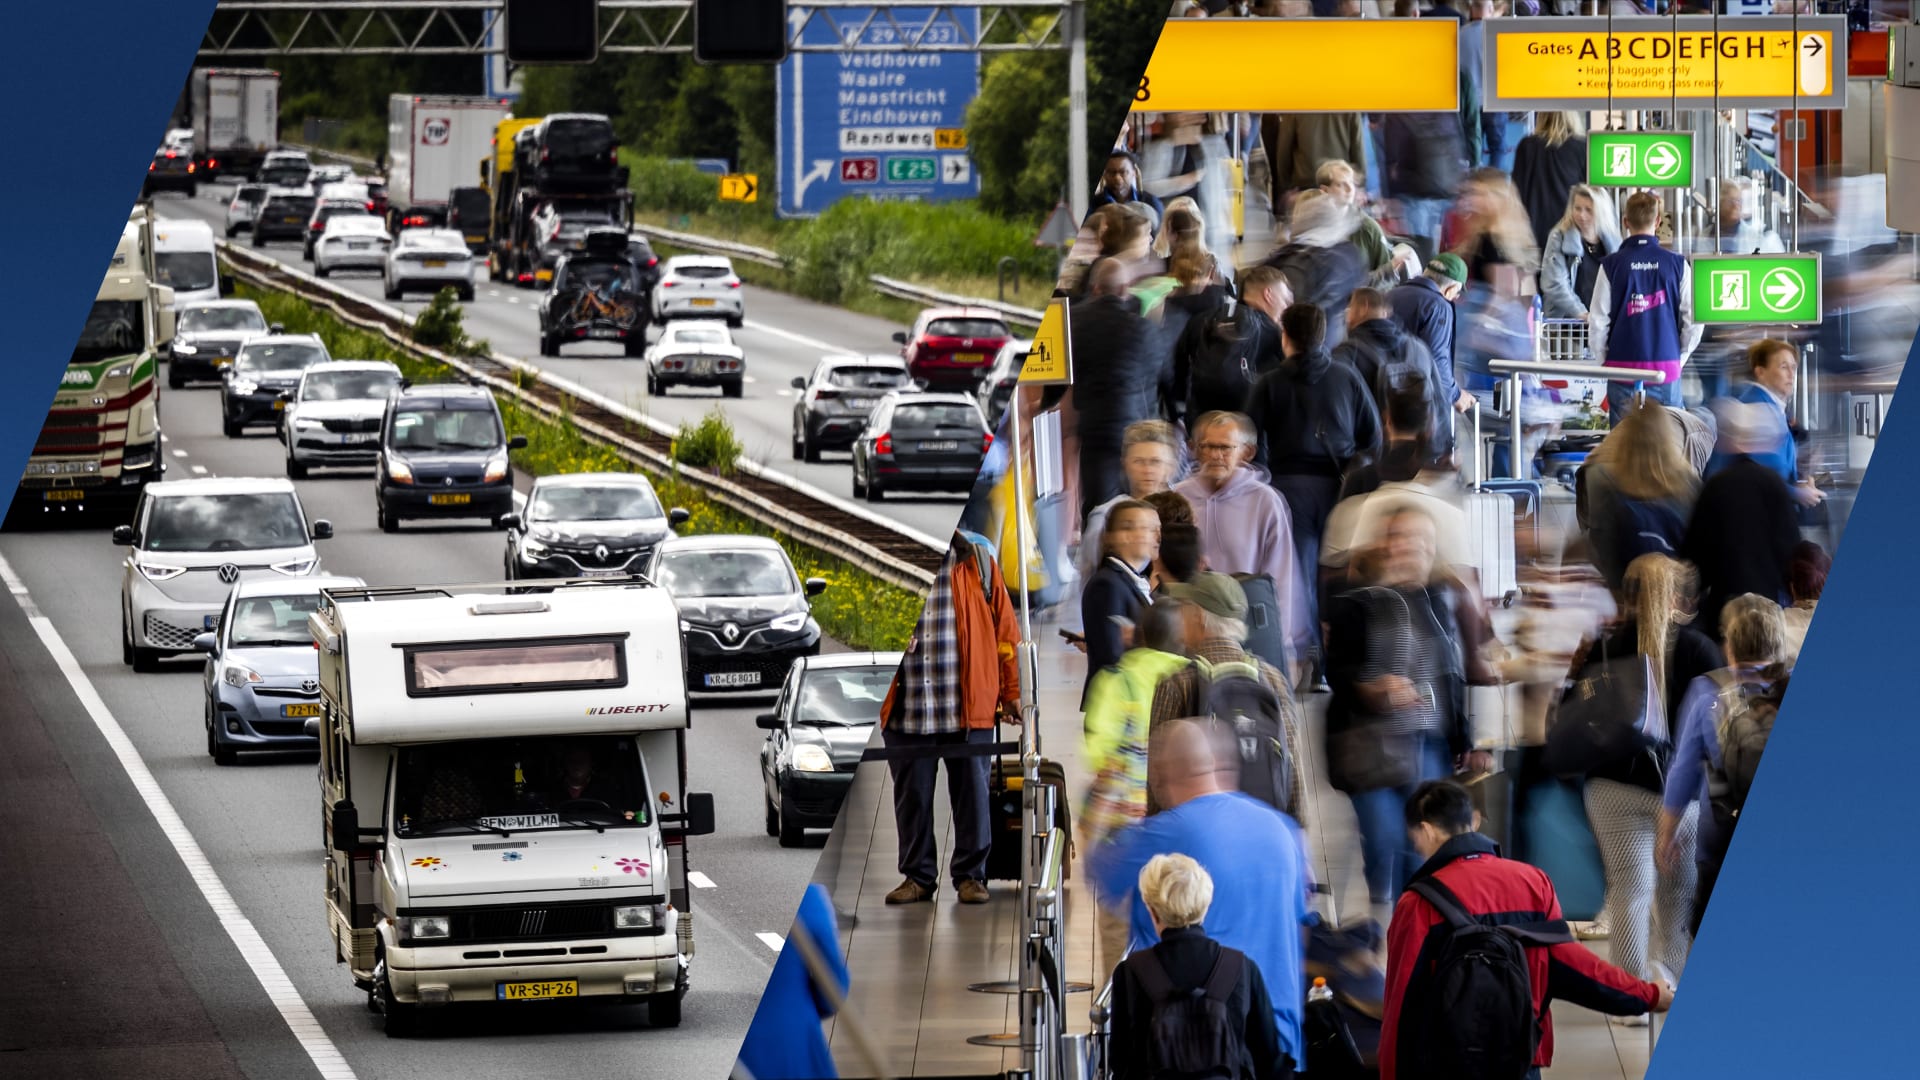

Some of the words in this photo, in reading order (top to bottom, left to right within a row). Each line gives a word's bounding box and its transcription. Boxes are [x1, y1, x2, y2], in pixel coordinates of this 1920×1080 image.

[1528, 42, 1573, 55] Gates
[839, 51, 942, 67] Veldhoven
[1586, 66, 1614, 75] Hand
[1618, 66, 1664, 76] baggage
[1668, 65, 1690, 76] only
[839, 71, 905, 87] Waalre
[1617, 79, 1664, 89] boarding
[1669, 80, 1691, 89] pass
[839, 89, 946, 106] Maastricht
[839, 108, 942, 125] Eindhoven
[428, 126, 448, 137] TIP
[846, 131, 932, 146] Randweg
[940, 133, 964, 146] N2
[845, 162, 876, 179] A2
[1631, 261, 1659, 271] Schiphol
[598, 703, 670, 715] LIBERTY
[516, 814, 559, 827] WILMA
[508, 983, 574, 997] VR-SH-26
